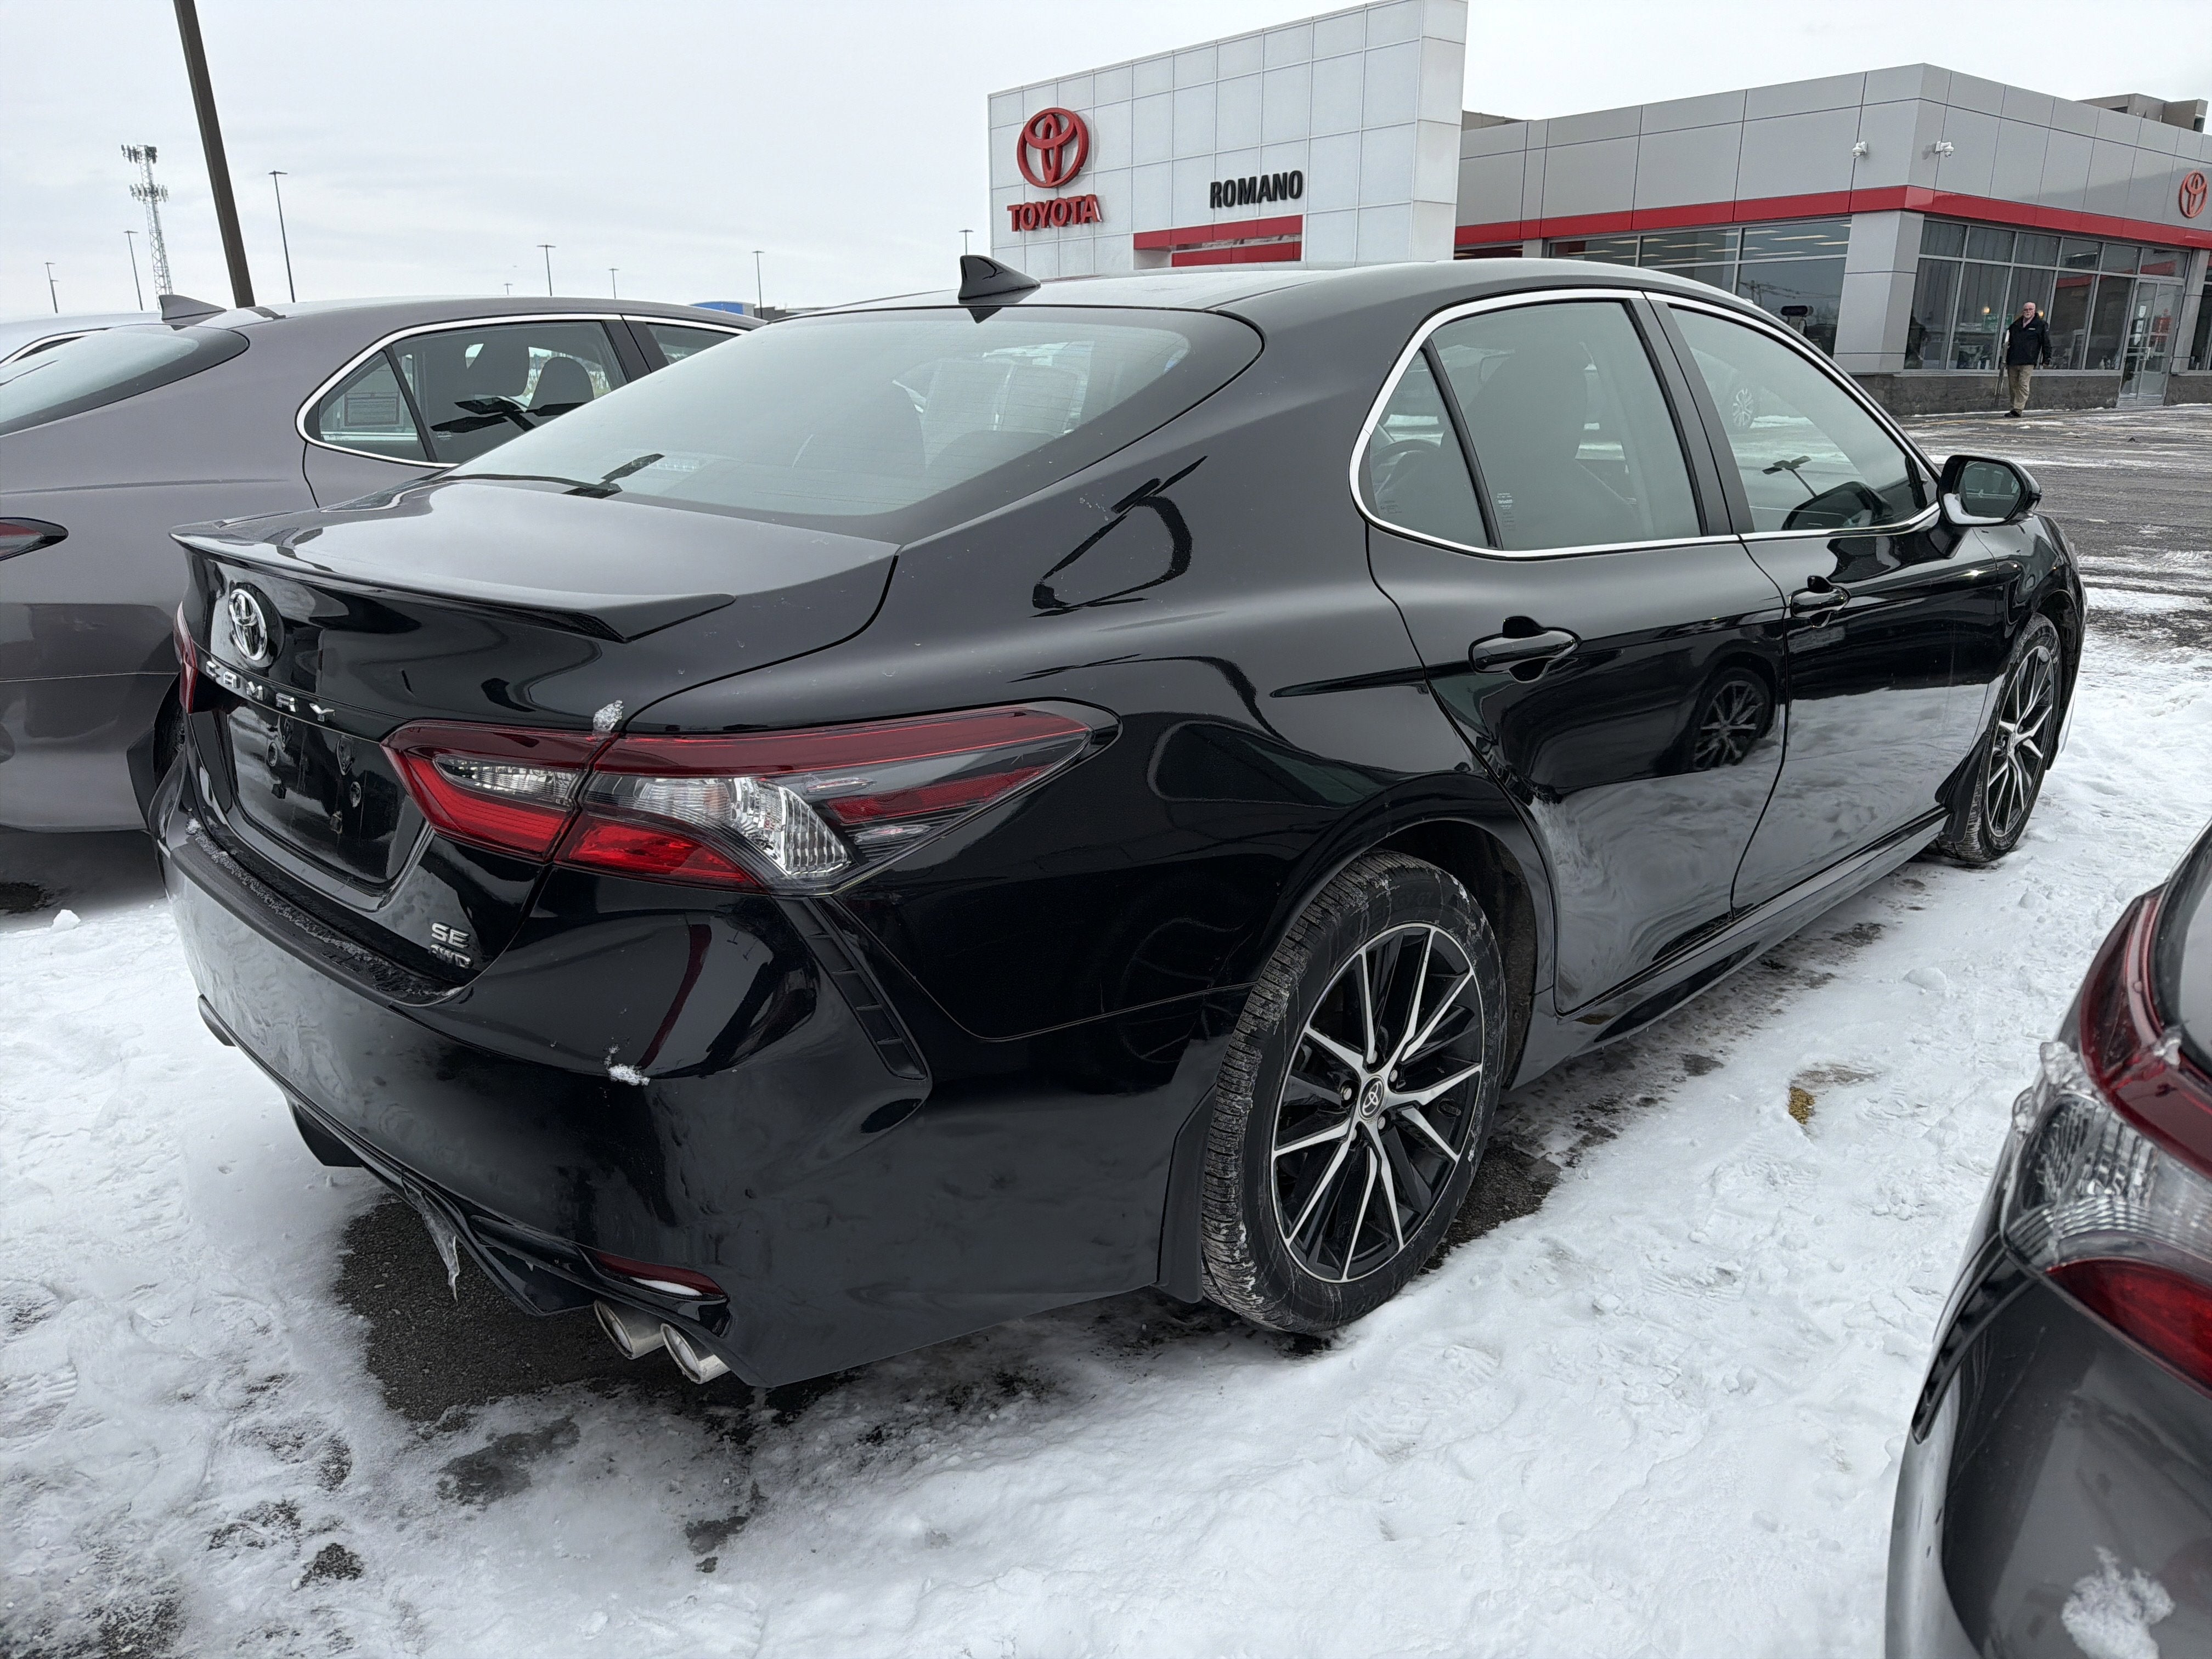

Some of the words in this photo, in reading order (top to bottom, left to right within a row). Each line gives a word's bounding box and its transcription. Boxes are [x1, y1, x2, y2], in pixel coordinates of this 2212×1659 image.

[1210, 170, 1303, 208] ROMANO
[1007, 194, 1102, 232] TOYOTA
[431, 923, 470, 949] SE
